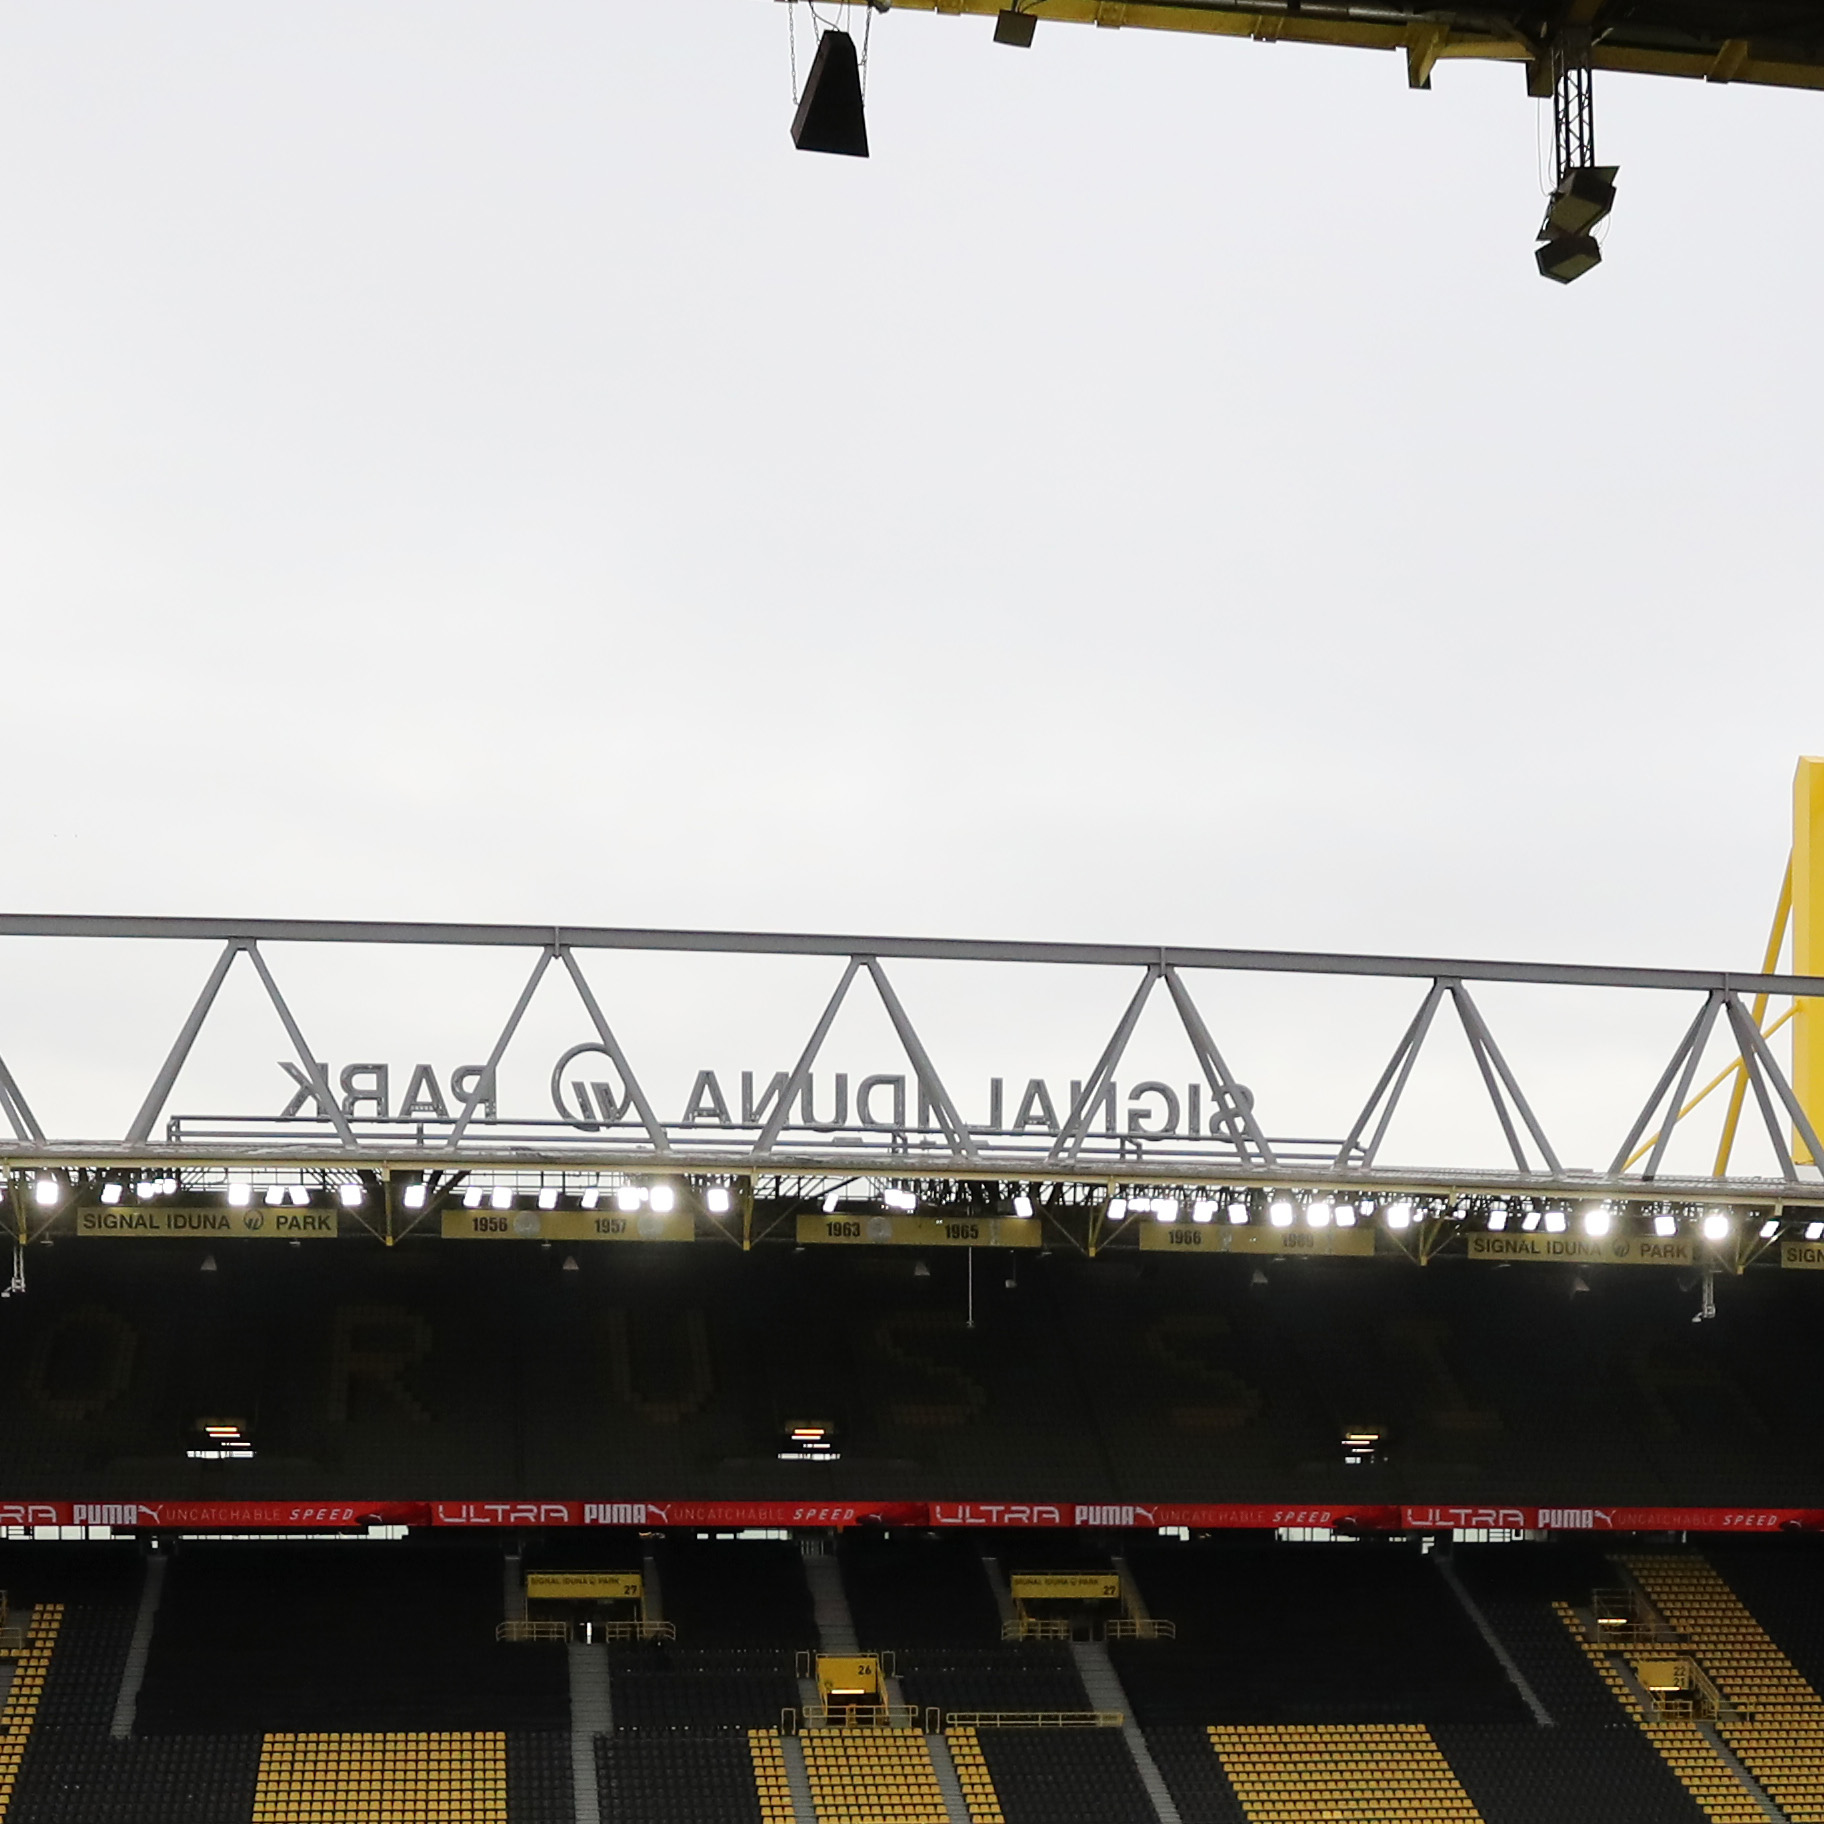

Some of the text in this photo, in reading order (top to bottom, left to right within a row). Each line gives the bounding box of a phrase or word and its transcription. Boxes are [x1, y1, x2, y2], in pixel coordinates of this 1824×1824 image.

[83, 1213, 331, 1231] SIGNAL IDUNA PARK
[472, 1216, 627, 1235] 1956 1957
[826, 1221, 979, 1240] 1963 1965
[1168, 1228, 1202, 1246] 1966
[1473, 1237, 1688, 1260] SIGNAL IDUNA PARK
[73, 1504, 137, 1524] PUMA
[166, 1507, 354, 1521] UNCATCHABLE SPEED
[437, 1504, 569, 1523] ULTRA
[584, 1504, 647, 1524] PUMA
[674, 1508, 855, 1521] UNCATCHABLE SPEED
[936, 1504, 1060, 1524] ULTRA
[1076, 1505, 1135, 1525] PUMA
[1272, 1509, 1332, 1522] SPEED
[1407, 1507, 1524, 1526] ULTRA
[1537, 1508, 1594, 1528] PUMA
[1723, 1513, 1778, 1525] SPEED
[624, 1585, 637, 1595] 27
[1103, 1585, 1116, 1596] 27
[858, 1665, 872, 1675] 26
